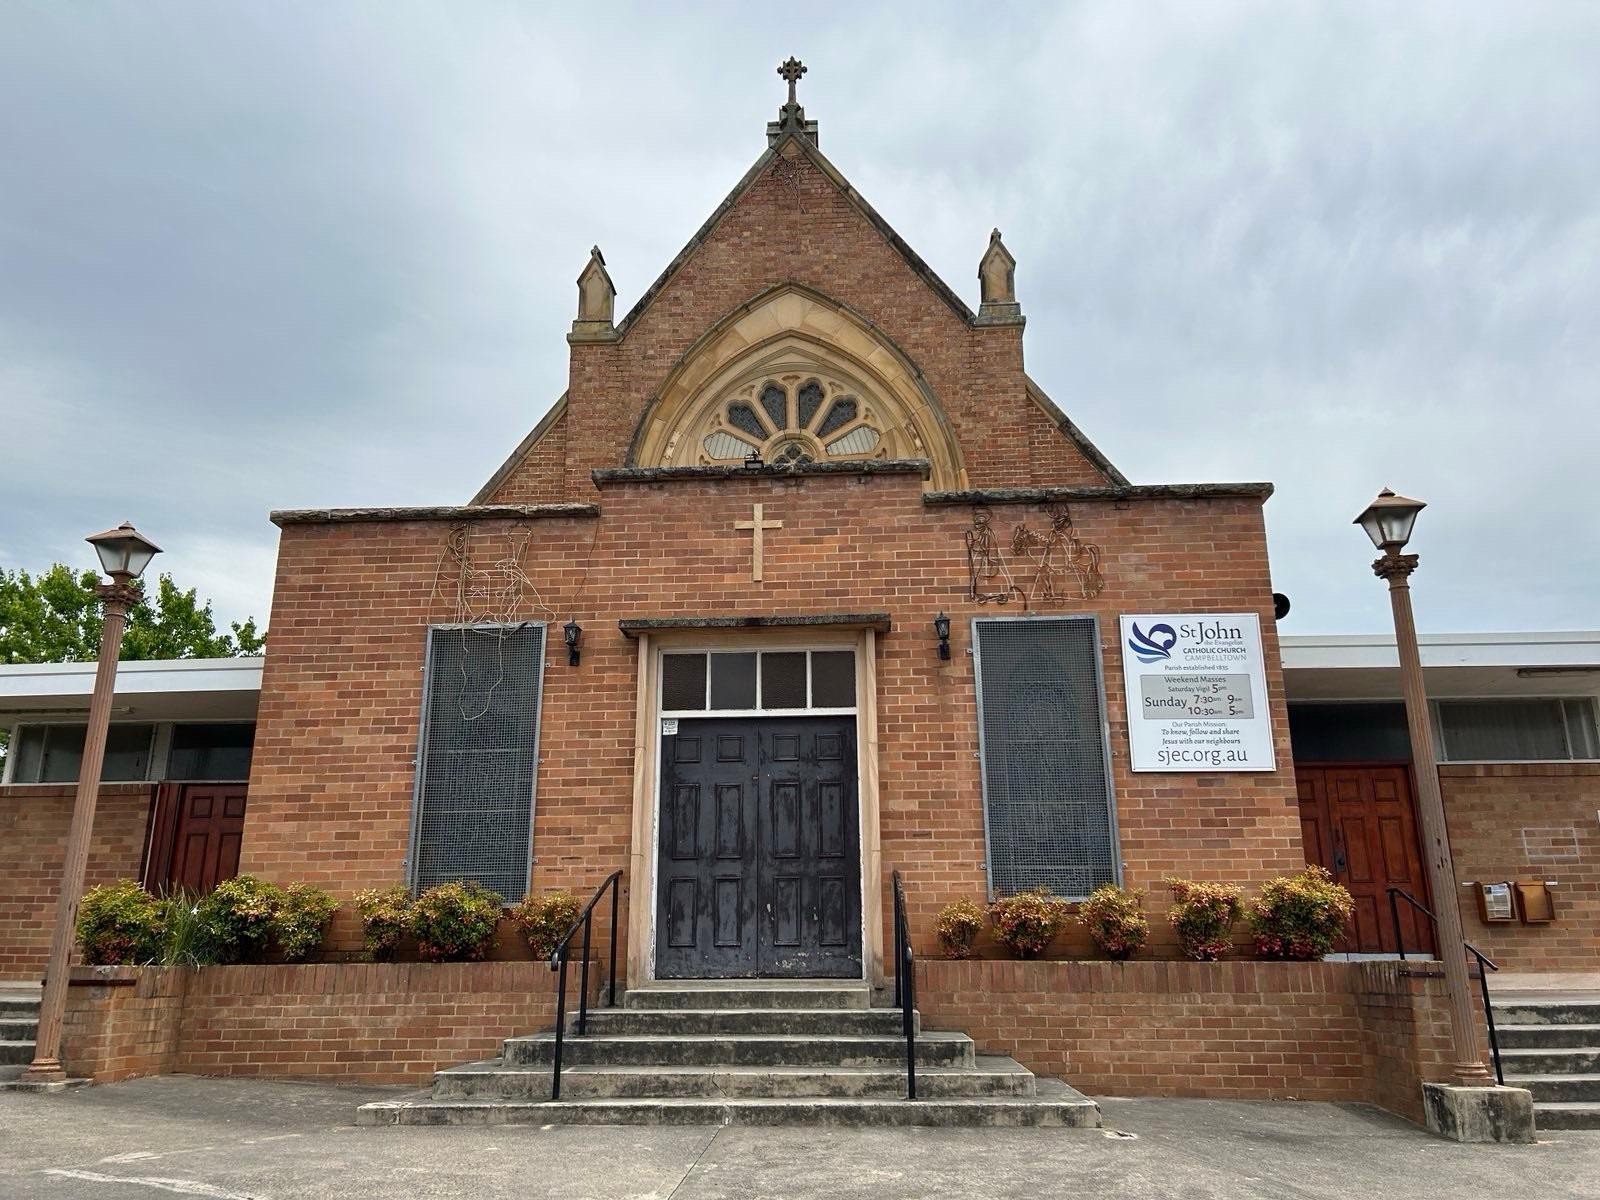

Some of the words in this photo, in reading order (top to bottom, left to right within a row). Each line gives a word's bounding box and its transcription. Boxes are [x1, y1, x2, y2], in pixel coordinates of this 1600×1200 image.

[1180, 624, 1196, 638] St
[1195, 621, 1242, 645] John
[1145, 696, 1187, 709] Sunday
[1171, 728, 1188, 736] know,
[1189, 728, 1208, 736] follow
[1206, 738, 1241, 746] neighbours
[1157, 746, 1248, 766] sjec.org.au
